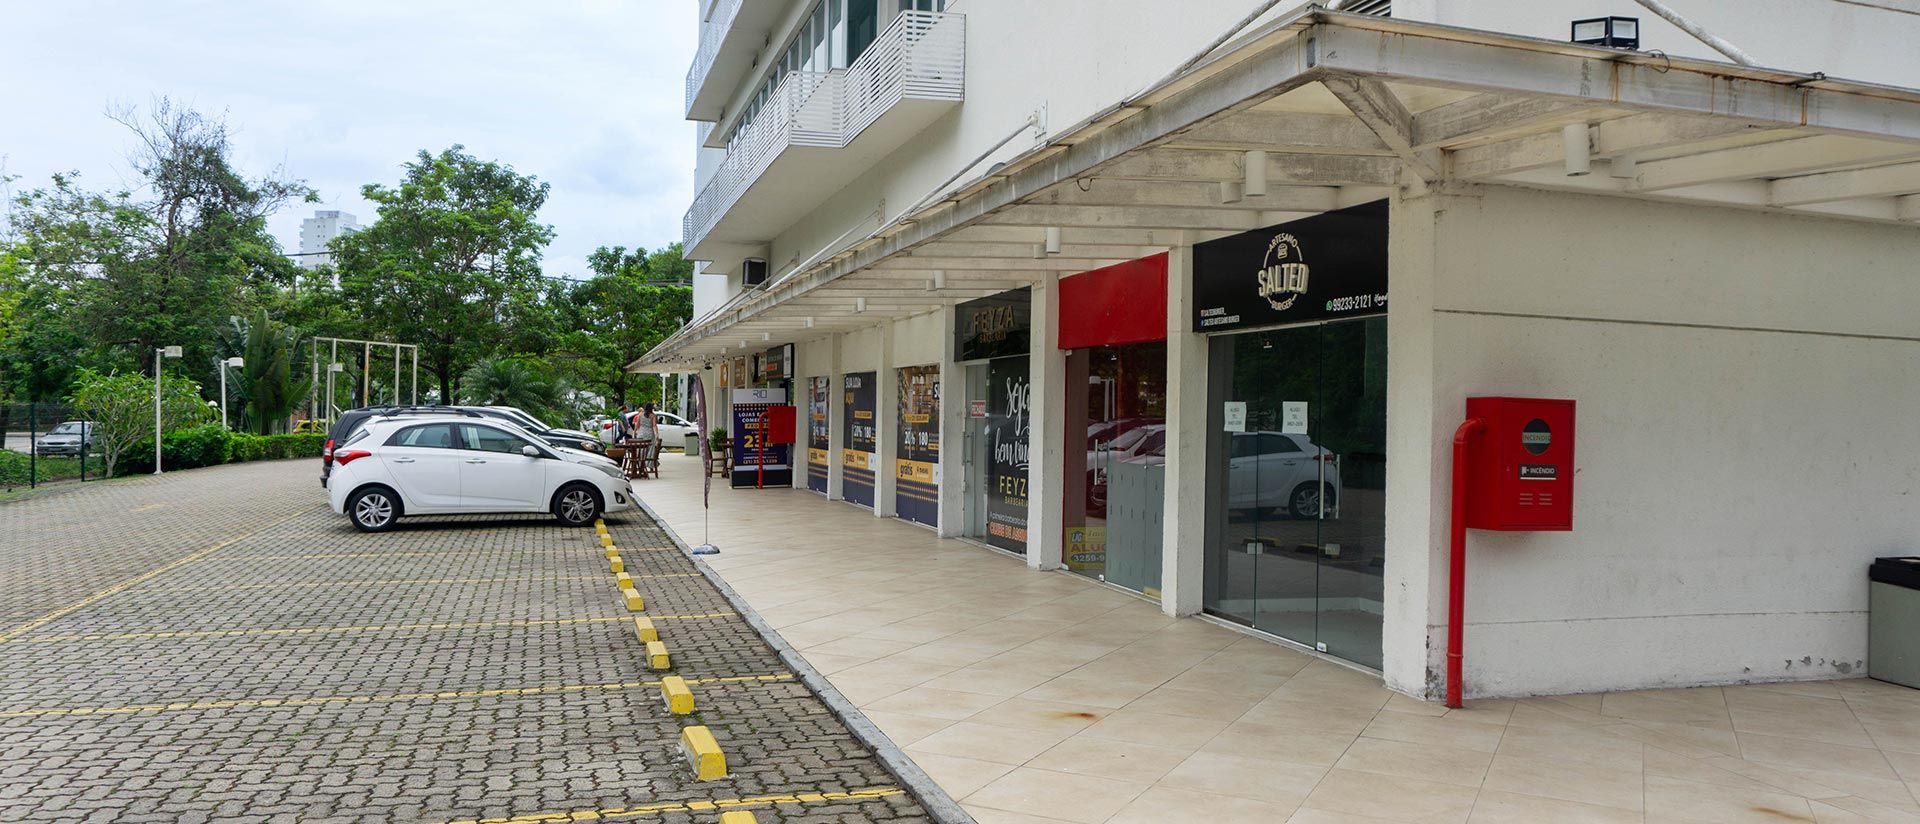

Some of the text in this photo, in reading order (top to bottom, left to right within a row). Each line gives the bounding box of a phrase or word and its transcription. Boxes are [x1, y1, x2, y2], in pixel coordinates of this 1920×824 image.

[1269, 232, 1298, 253] ARTESANO
[1258, 263, 1309, 298] SALTED
[1271, 298, 1294, 311] BURGER
[1333, 294, 1372, 311] 99233-2121
[972, 304, 1014, 336] FEYZA
[1000, 475, 1027, 496] FEYZ
